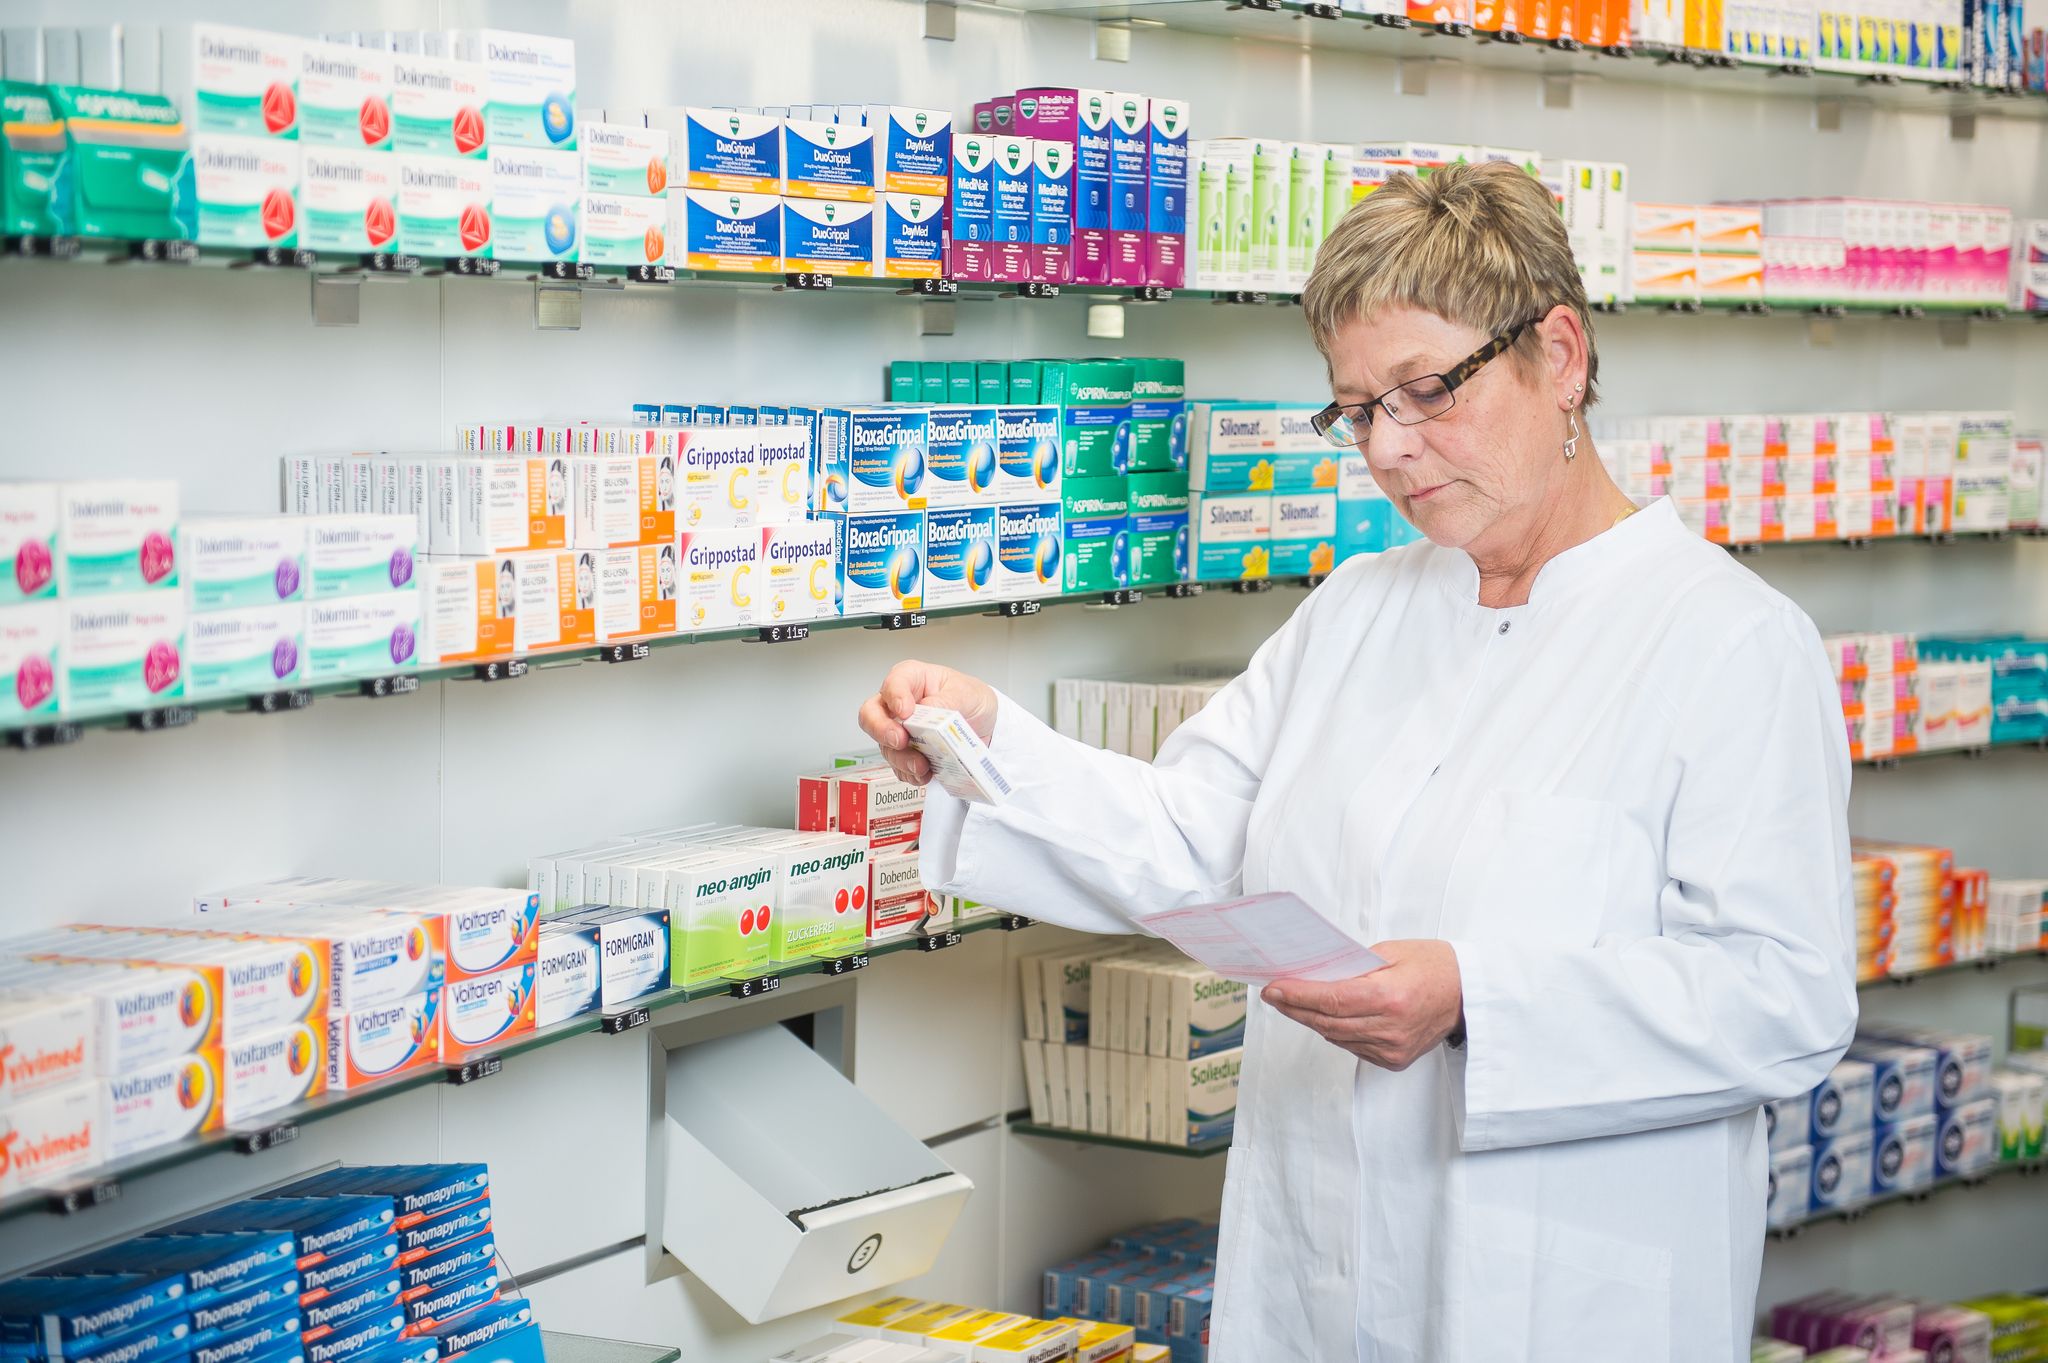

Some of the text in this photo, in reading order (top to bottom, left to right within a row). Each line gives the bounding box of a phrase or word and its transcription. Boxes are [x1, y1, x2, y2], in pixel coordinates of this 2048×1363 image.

[488, 42, 538, 65] Dolormin
[394, 64, 452, 90] Dolormin
[590, 128, 624, 146] Dolormin
[905, 138, 935, 154] DayMed
[716, 139, 756, 159] DuoGrippal
[813, 149, 851, 168] DuoGrippal
[402, 164, 458, 189] Dolormin
[493, 155, 543, 178] Dolormin
[958, 177, 989, 192] MediNait
[998, 180, 1028, 194] MediNait
[1038, 183, 1068, 197] MediNait
[587, 198, 622, 216] Dolormin
[716, 219, 756, 238] DuoGrippal
[812, 226, 850, 244] DuoGrippal
[902, 224, 929, 239] DayMed
[458, 257, 469, 272] €
[555, 261, 566, 276] €
[640, 264, 649, 279] €
[799, 275, 807, 287] €
[925, 280, 933, 292] €
[1029, 284, 1037, 295] €
[1076, 387, 1108, 400] ASPIRIN
[854, 424, 925, 450] BoxaGrippal
[929, 418, 996, 445] BoxaGrippal
[1000, 417, 1058, 443] BoxaGrippal
[1219, 417, 1261, 437] Silomat
[1281, 417, 1316, 434] Siloma
[839, 417, 848, 463] BoxaGrippal
[687, 445, 754, 471] Grippostad
[760, 441, 805, 466] ippostad
[728, 467, 749, 509] C
[782, 462, 801, 504] C
[1072, 499, 1103, 513] ASPIRIN
[1210, 506, 1254, 524] Silomat
[1280, 503, 1320, 521] Silomat
[849, 522, 920, 551] BoxaGrippal
[929, 517, 994, 544] BoxaGrippal
[1000, 512, 1060, 538] BoxaGrippal
[690, 543, 756, 569] Grippostad
[770, 537, 832, 563] Grippostad
[731, 565, 751, 607] C
[809, 559, 828, 601] C
[1010, 602, 1018, 615] €
[1114, 591, 1122, 604] €
[893, 616, 902, 627] €
[771, 627, 780, 641] €
[613, 646, 623, 661] €
[487, 663, 498, 679] €
[875, 787, 919, 806] Dobendan
[456, 908, 506, 931] Voltaren
[1011, 916, 1020, 929] €
[787, 921, 836, 943] ZUCKERFREI
[929, 937, 937, 949] €
[350, 935, 404, 960] Voltaren
[605, 931, 655, 958] FORMIGRAN
[228, 960, 287, 987] Voltaren
[332, 941, 344, 1008] Voltaren
[541, 949, 588, 977] FORMIGRAN
[834, 960, 843, 973] €
[1064, 963, 1091, 985] Sole
[452, 980, 502, 1003] Voltaren
[743, 982, 751, 996] €
[354, 1006, 405, 1032] Voltaren
[615, 1017, 623, 1031] €
[9, 1036, 84, 1082] vivimed
[231, 1039, 286, 1068] Voltaren
[329, 1018, 341, 1084] Voltaren
[110, 1071, 174, 1101] Voltaren
[461, 1067, 472, 1082] €
[13, 1122, 91, 1169] vivimed
[403, 1177, 466, 1212] Thomapyrin
[302, 1218, 370, 1254] Thomapyrin
[406, 1214, 469, 1248] Thomapyrin
[190, 1250, 267, 1290] Thomapyrin
[304, 1252, 374, 1290] Thomapyrin
[409, 1251, 472, 1286] Thomapyrin
[195, 1289, 271, 1330] Thomapyrin
[308, 1289, 376, 1327] Thomapyrin
[412, 1283, 476, 1319] Thomapyrin
[72, 1294, 155, 1338] Thomapyrin
[197, 1327, 272, 1363] Thomapyrin
[311, 1325, 380, 1363] Thomapyrin
[446, 1315, 509, 1353] Thomapyrin
